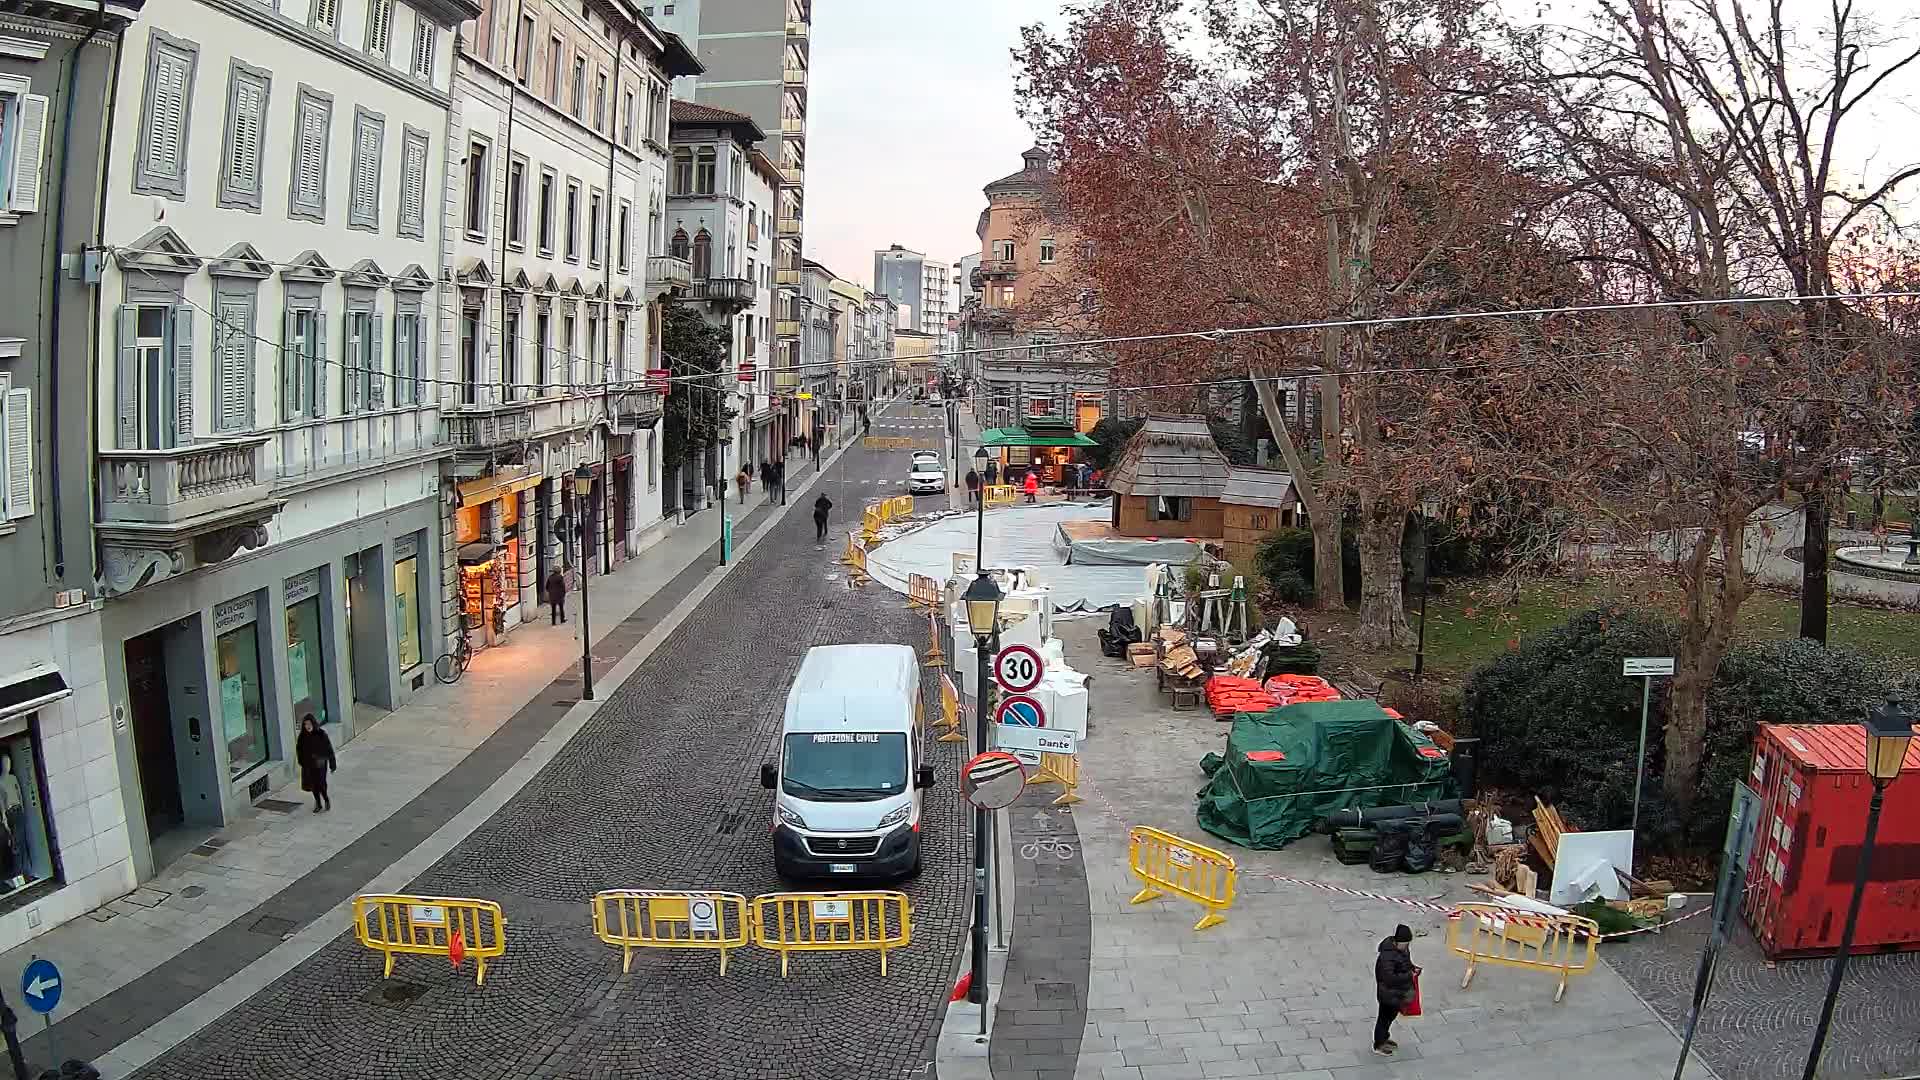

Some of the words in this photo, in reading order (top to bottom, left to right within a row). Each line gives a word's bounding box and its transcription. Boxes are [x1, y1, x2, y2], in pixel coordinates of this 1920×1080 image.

[1005, 657, 1033, 680] 30
[813, 733, 855, 744] PROTEZIONE
[856, 733, 880, 743] CIVILE
[1038, 738, 1070, 749] Dante
